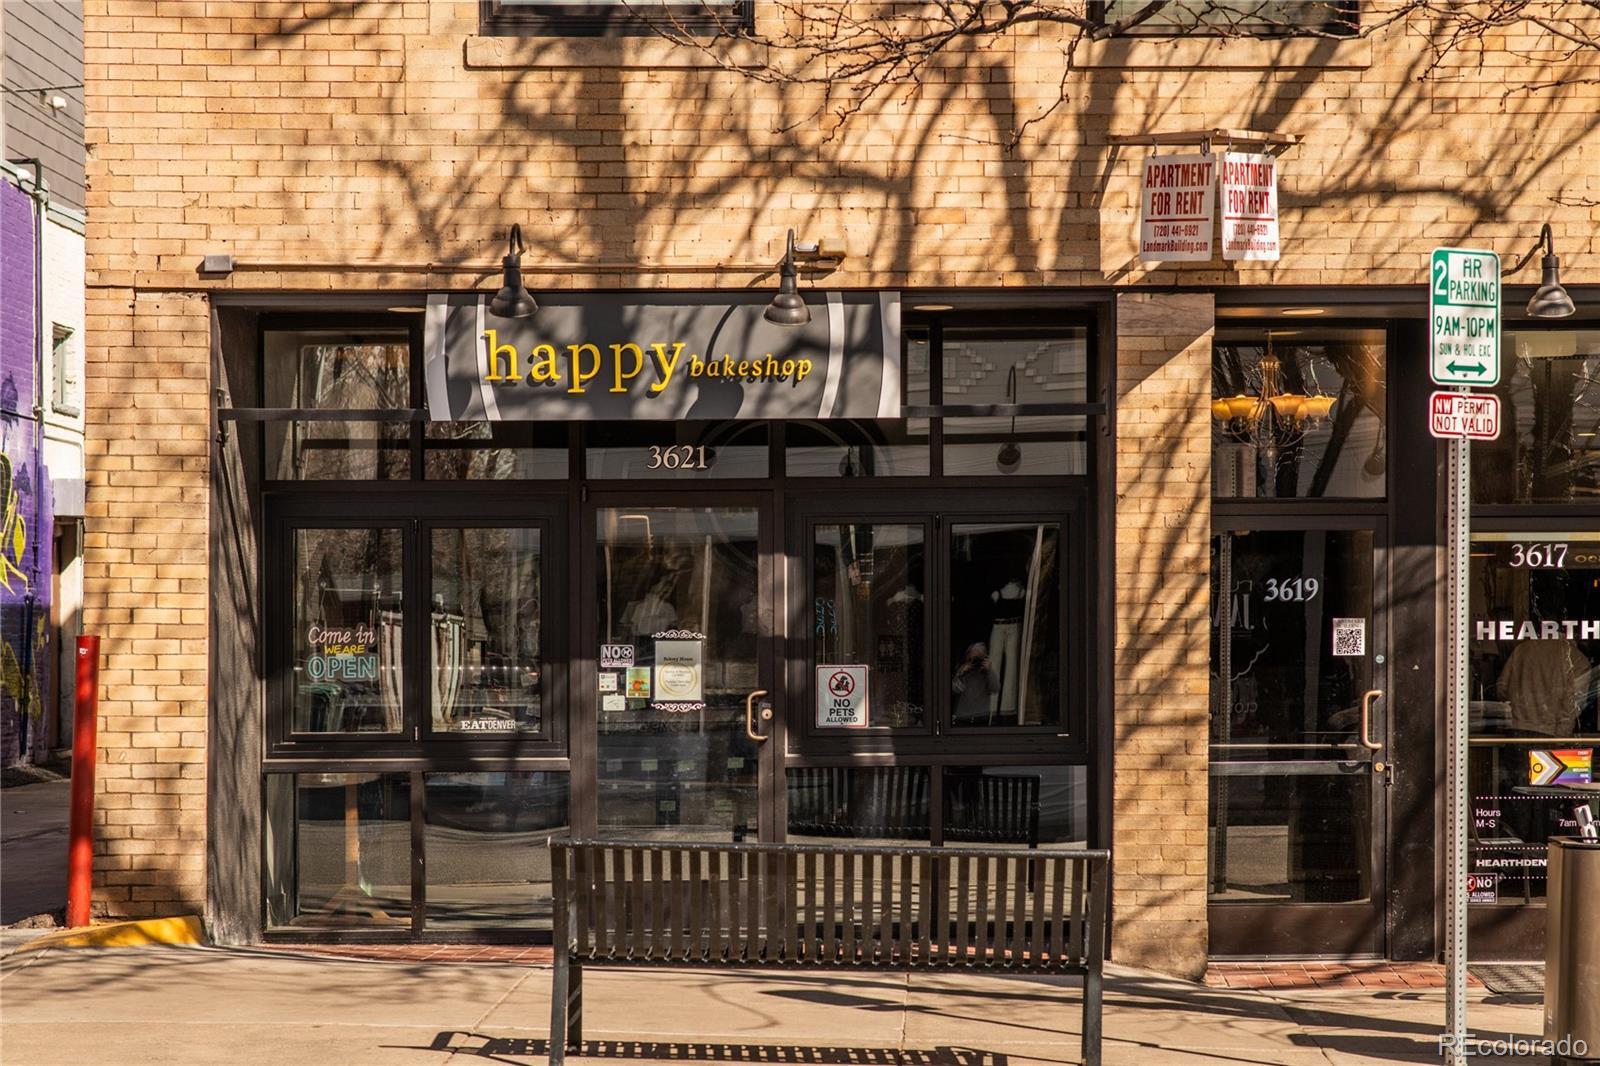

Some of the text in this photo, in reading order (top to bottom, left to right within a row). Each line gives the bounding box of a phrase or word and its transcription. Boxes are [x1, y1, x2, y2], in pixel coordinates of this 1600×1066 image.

[1146, 163, 1212, 188] APARTMENT
[1223, 162, 1273, 187] APARTMENT
[1151, 191, 1205, 215] FOR RENT
[1229, 192, 1270, 214] FOR RENT
[1143, 240, 1208, 253] LandmarkBuilding.com
[1434, 259, 1482, 296] 2 HR
[1450, 281, 1495, 302] PARKING
[1436, 316, 1495, 338] 9AM-10PM
[1439, 343, 1491, 357] SUN & HOL EXC
[483, 329, 813, 393] happy bakeshop
[1435, 399, 1491, 416] NW PERMIT
[1436, 416, 1494, 433] NOT VALID
[647, 445, 708, 470] 3621
[1509, 543, 1568, 568] 3617
[1264, 578, 1319, 602] 3619
[308, 626, 375, 644] Come in
[1476, 621, 1600, 640] HEARTH
[324, 645, 365, 655] WE ARE
[602, 646, 621, 659] NO
[308, 656, 376, 679] OPEN
[834, 698, 850, 708] NO
[829, 708, 855, 717] PETS
[1476, 808, 1501, 817] Hours
[1476, 819, 1496, 828] M-S
[1476, 859, 1548, 867] HEARTHDEN
[1476, 879, 1492, 888] NO
